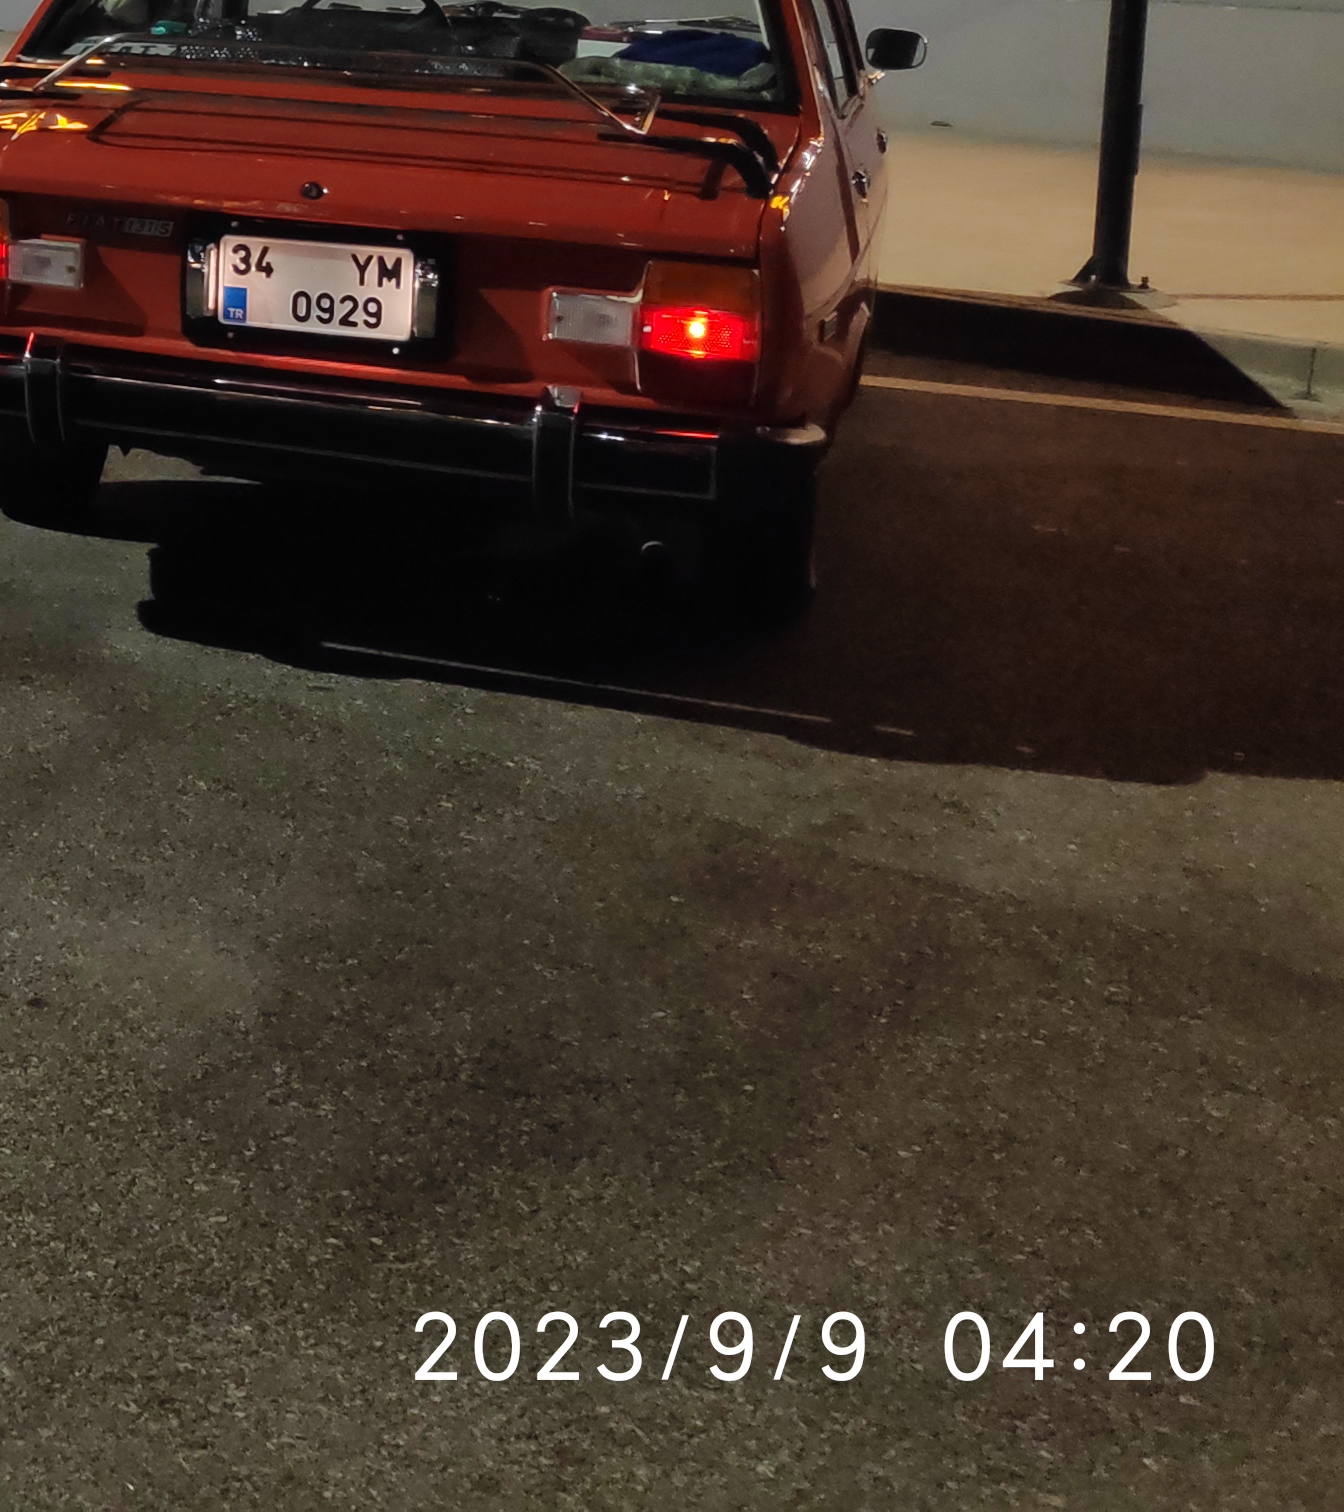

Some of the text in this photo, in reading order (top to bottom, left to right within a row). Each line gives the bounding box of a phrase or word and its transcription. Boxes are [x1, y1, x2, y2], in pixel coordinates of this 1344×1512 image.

[231, 243, 403, 290] 34 YM
[226, 307, 244, 320] TR
[291, 290, 383, 329] 0929
